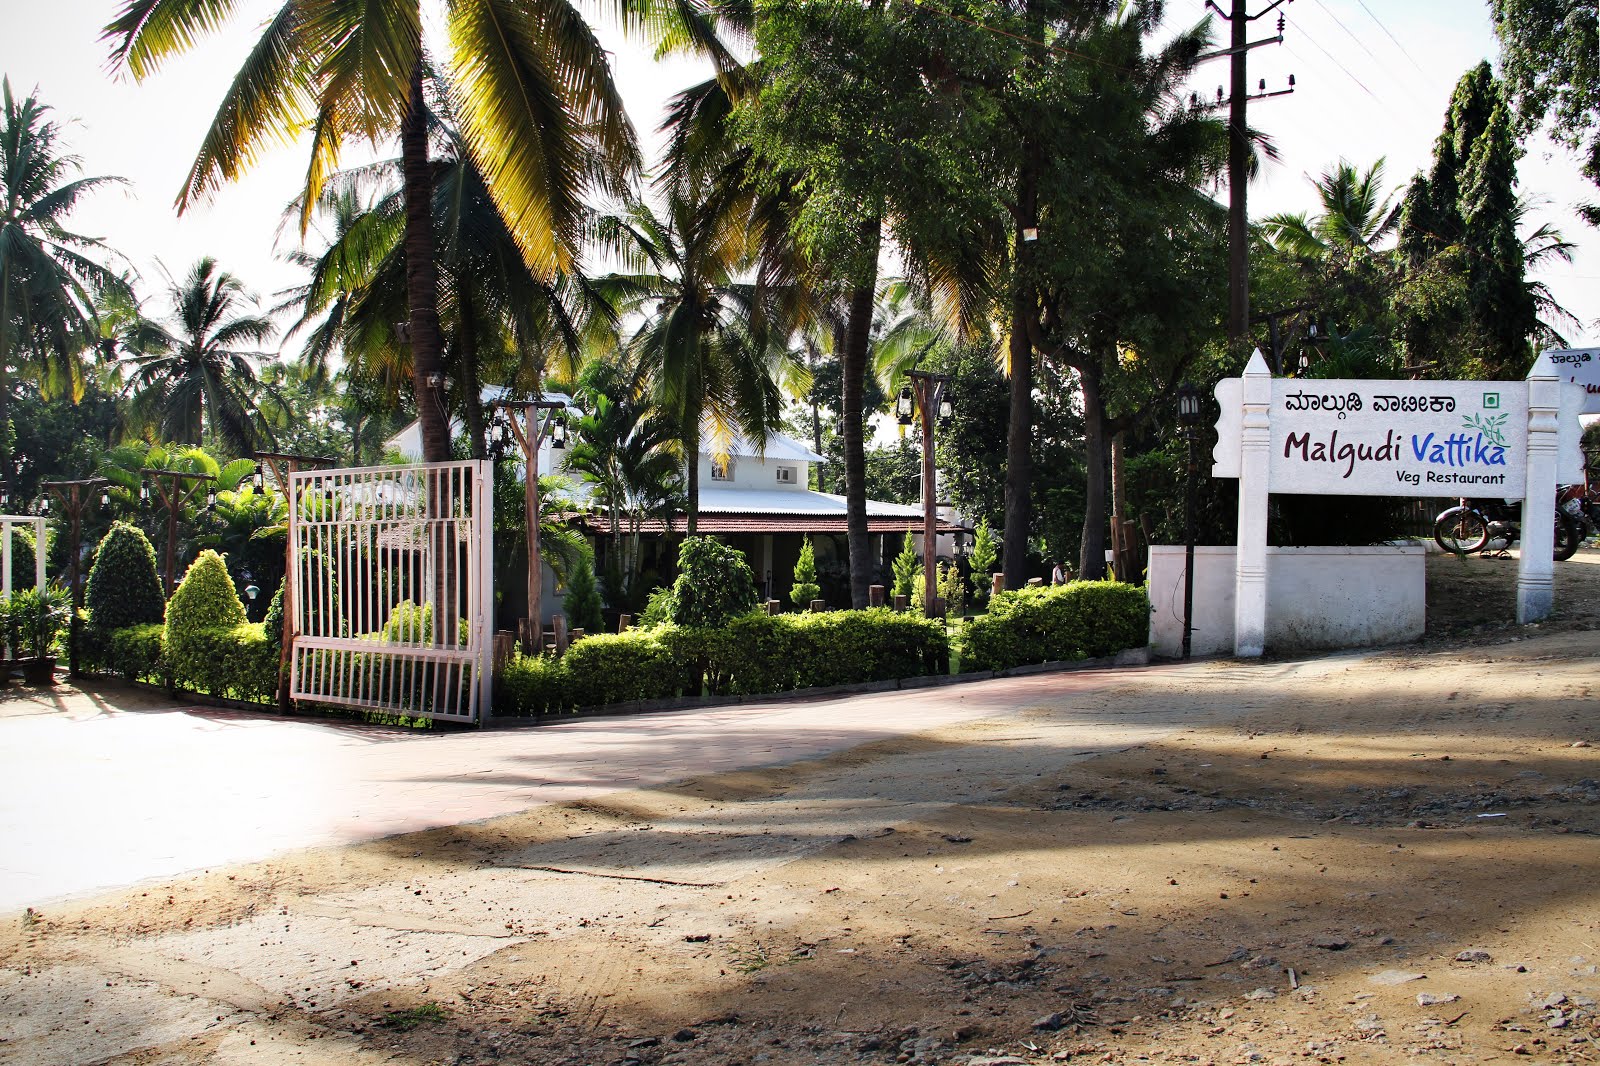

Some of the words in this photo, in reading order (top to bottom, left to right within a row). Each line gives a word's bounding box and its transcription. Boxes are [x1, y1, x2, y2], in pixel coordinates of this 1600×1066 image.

[1285, 389, 1363, 420] ಮಾಲ್ಗುಡಿ
[1373, 395, 1456, 413] ವಾಟೀಕಾ
[1284, 429, 1402, 479] Malgudi
[1411, 432, 1506, 467] Vattika
[1396, 470, 1421, 486] Veg
[1426, 471, 1506, 485] Restaurant
